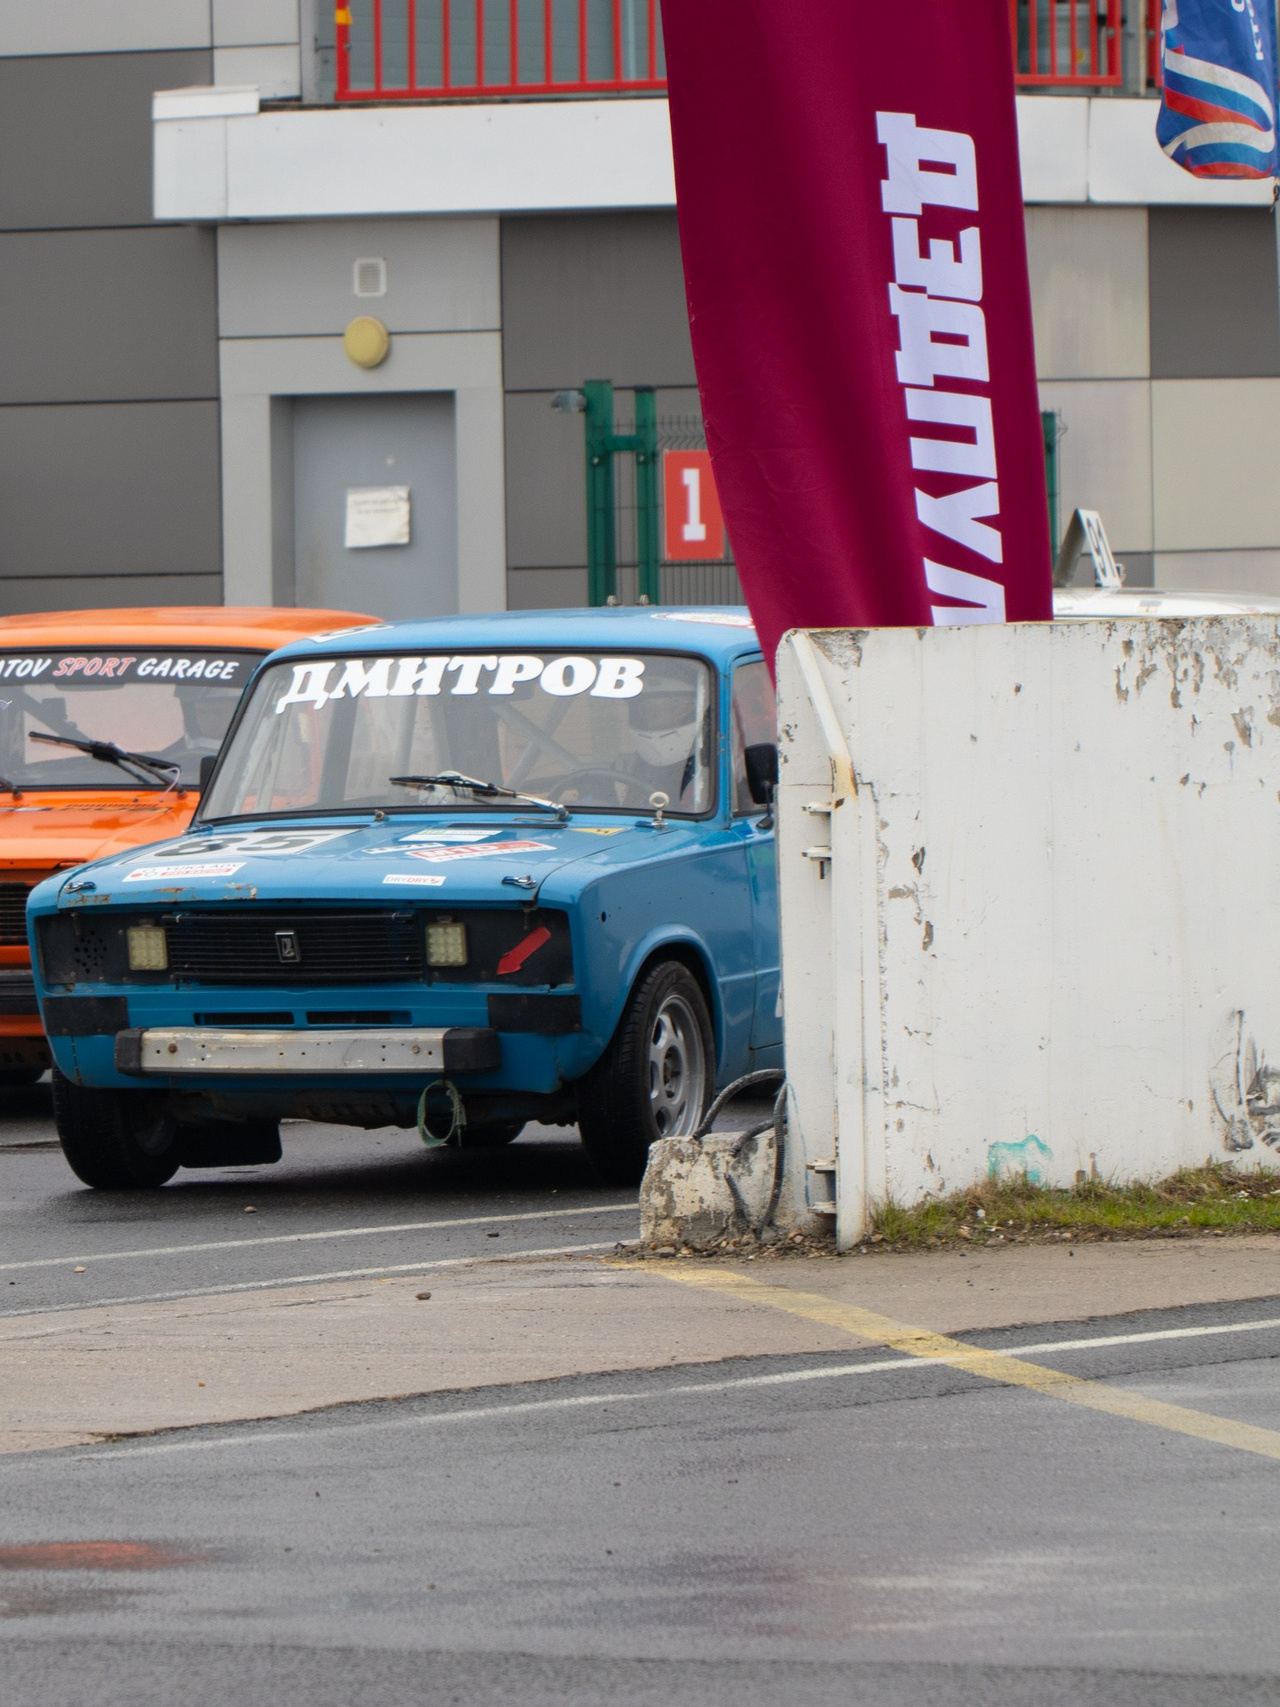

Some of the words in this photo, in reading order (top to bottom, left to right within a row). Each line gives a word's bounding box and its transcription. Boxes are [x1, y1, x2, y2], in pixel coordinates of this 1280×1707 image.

[681, 467, 706, 542] 1
[53, 656, 137, 677] SPORT
[136, 657, 240, 680] GARAGE
[275, 655, 646, 715] ДМИТРОВ
